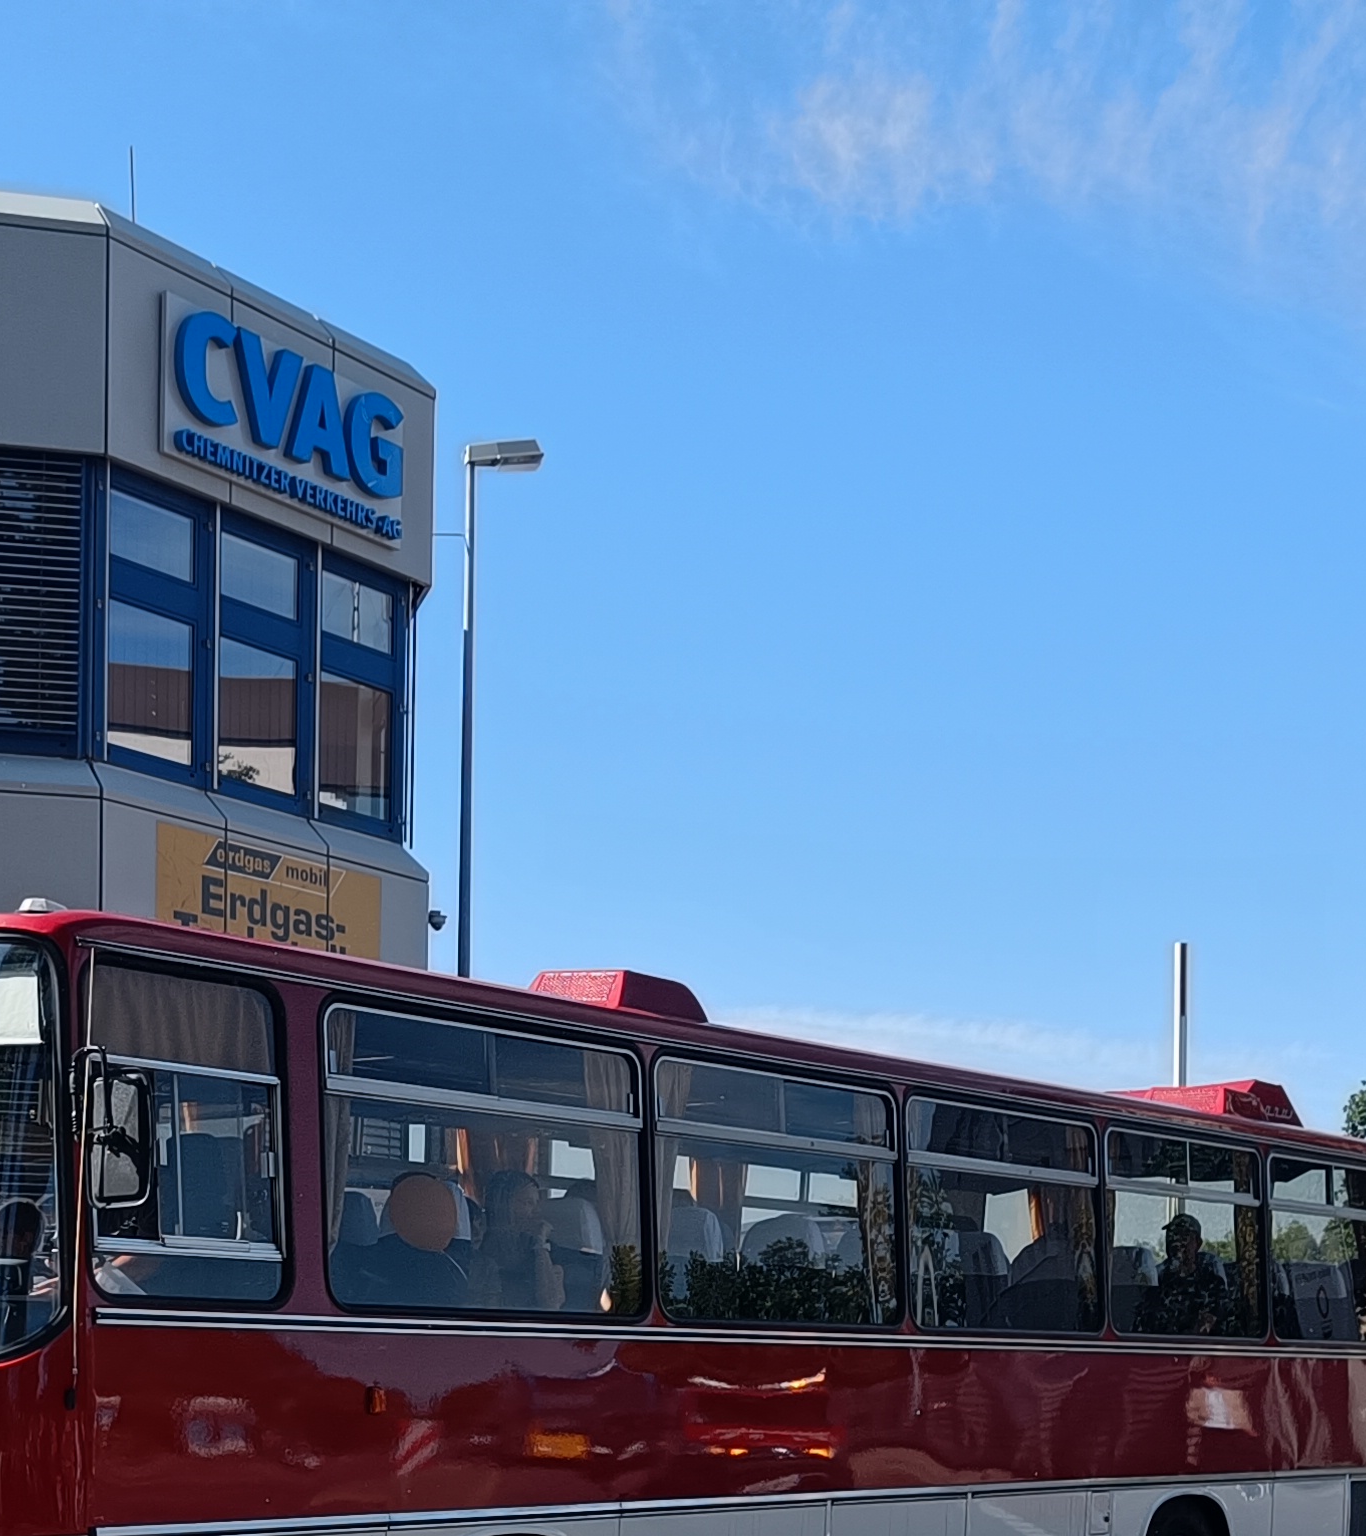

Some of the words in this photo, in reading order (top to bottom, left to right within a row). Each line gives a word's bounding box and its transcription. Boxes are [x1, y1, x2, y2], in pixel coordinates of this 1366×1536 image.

[174, 311, 404, 499] CVAG
[175, 429, 291, 495] CHEMNITZER
[215, 847, 272, 874] erdgas
[285, 864, 328, 888] mobil
[201, 874, 346, 943] Erdgas-
